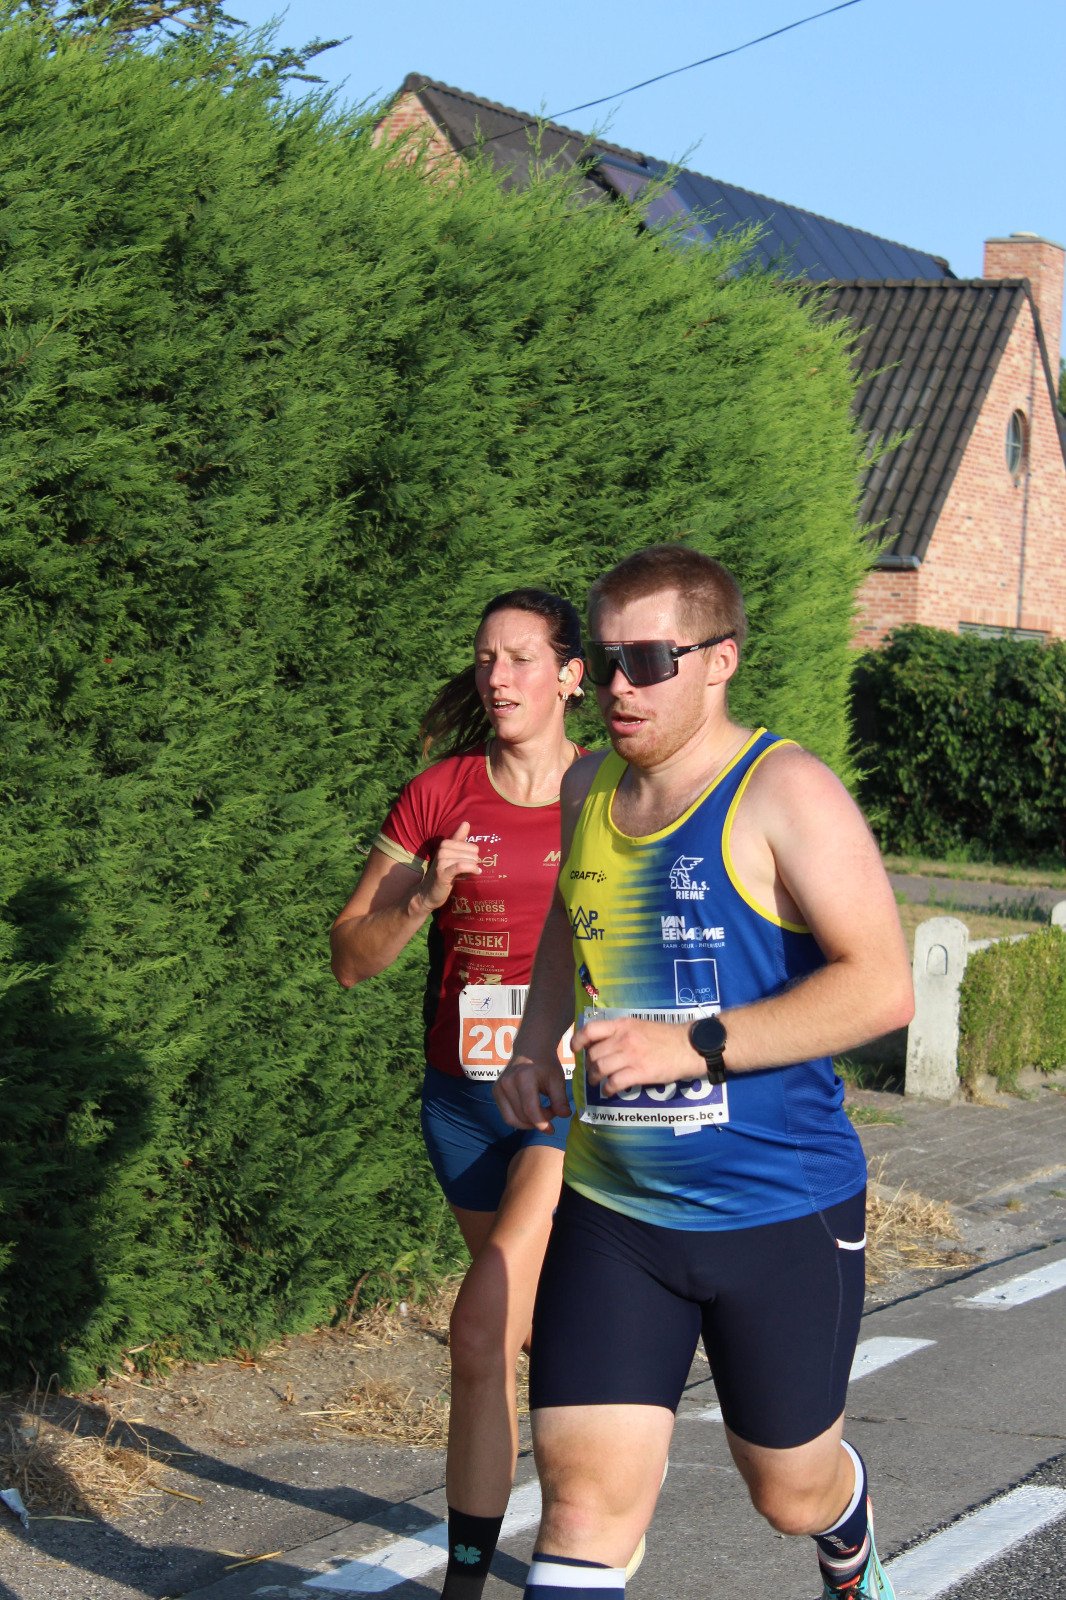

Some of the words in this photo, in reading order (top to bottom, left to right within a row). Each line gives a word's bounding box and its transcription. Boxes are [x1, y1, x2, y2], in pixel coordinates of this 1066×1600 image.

[570, 870, 598, 881] CRAFT
[691, 880, 710, 891] A.S.
[675, 890, 705, 900] RIEME
[474, 904, 506, 914] press
[660, 915, 686, 928] VAN
[592, 1111, 715, 1125] www.krekenlopers.be
